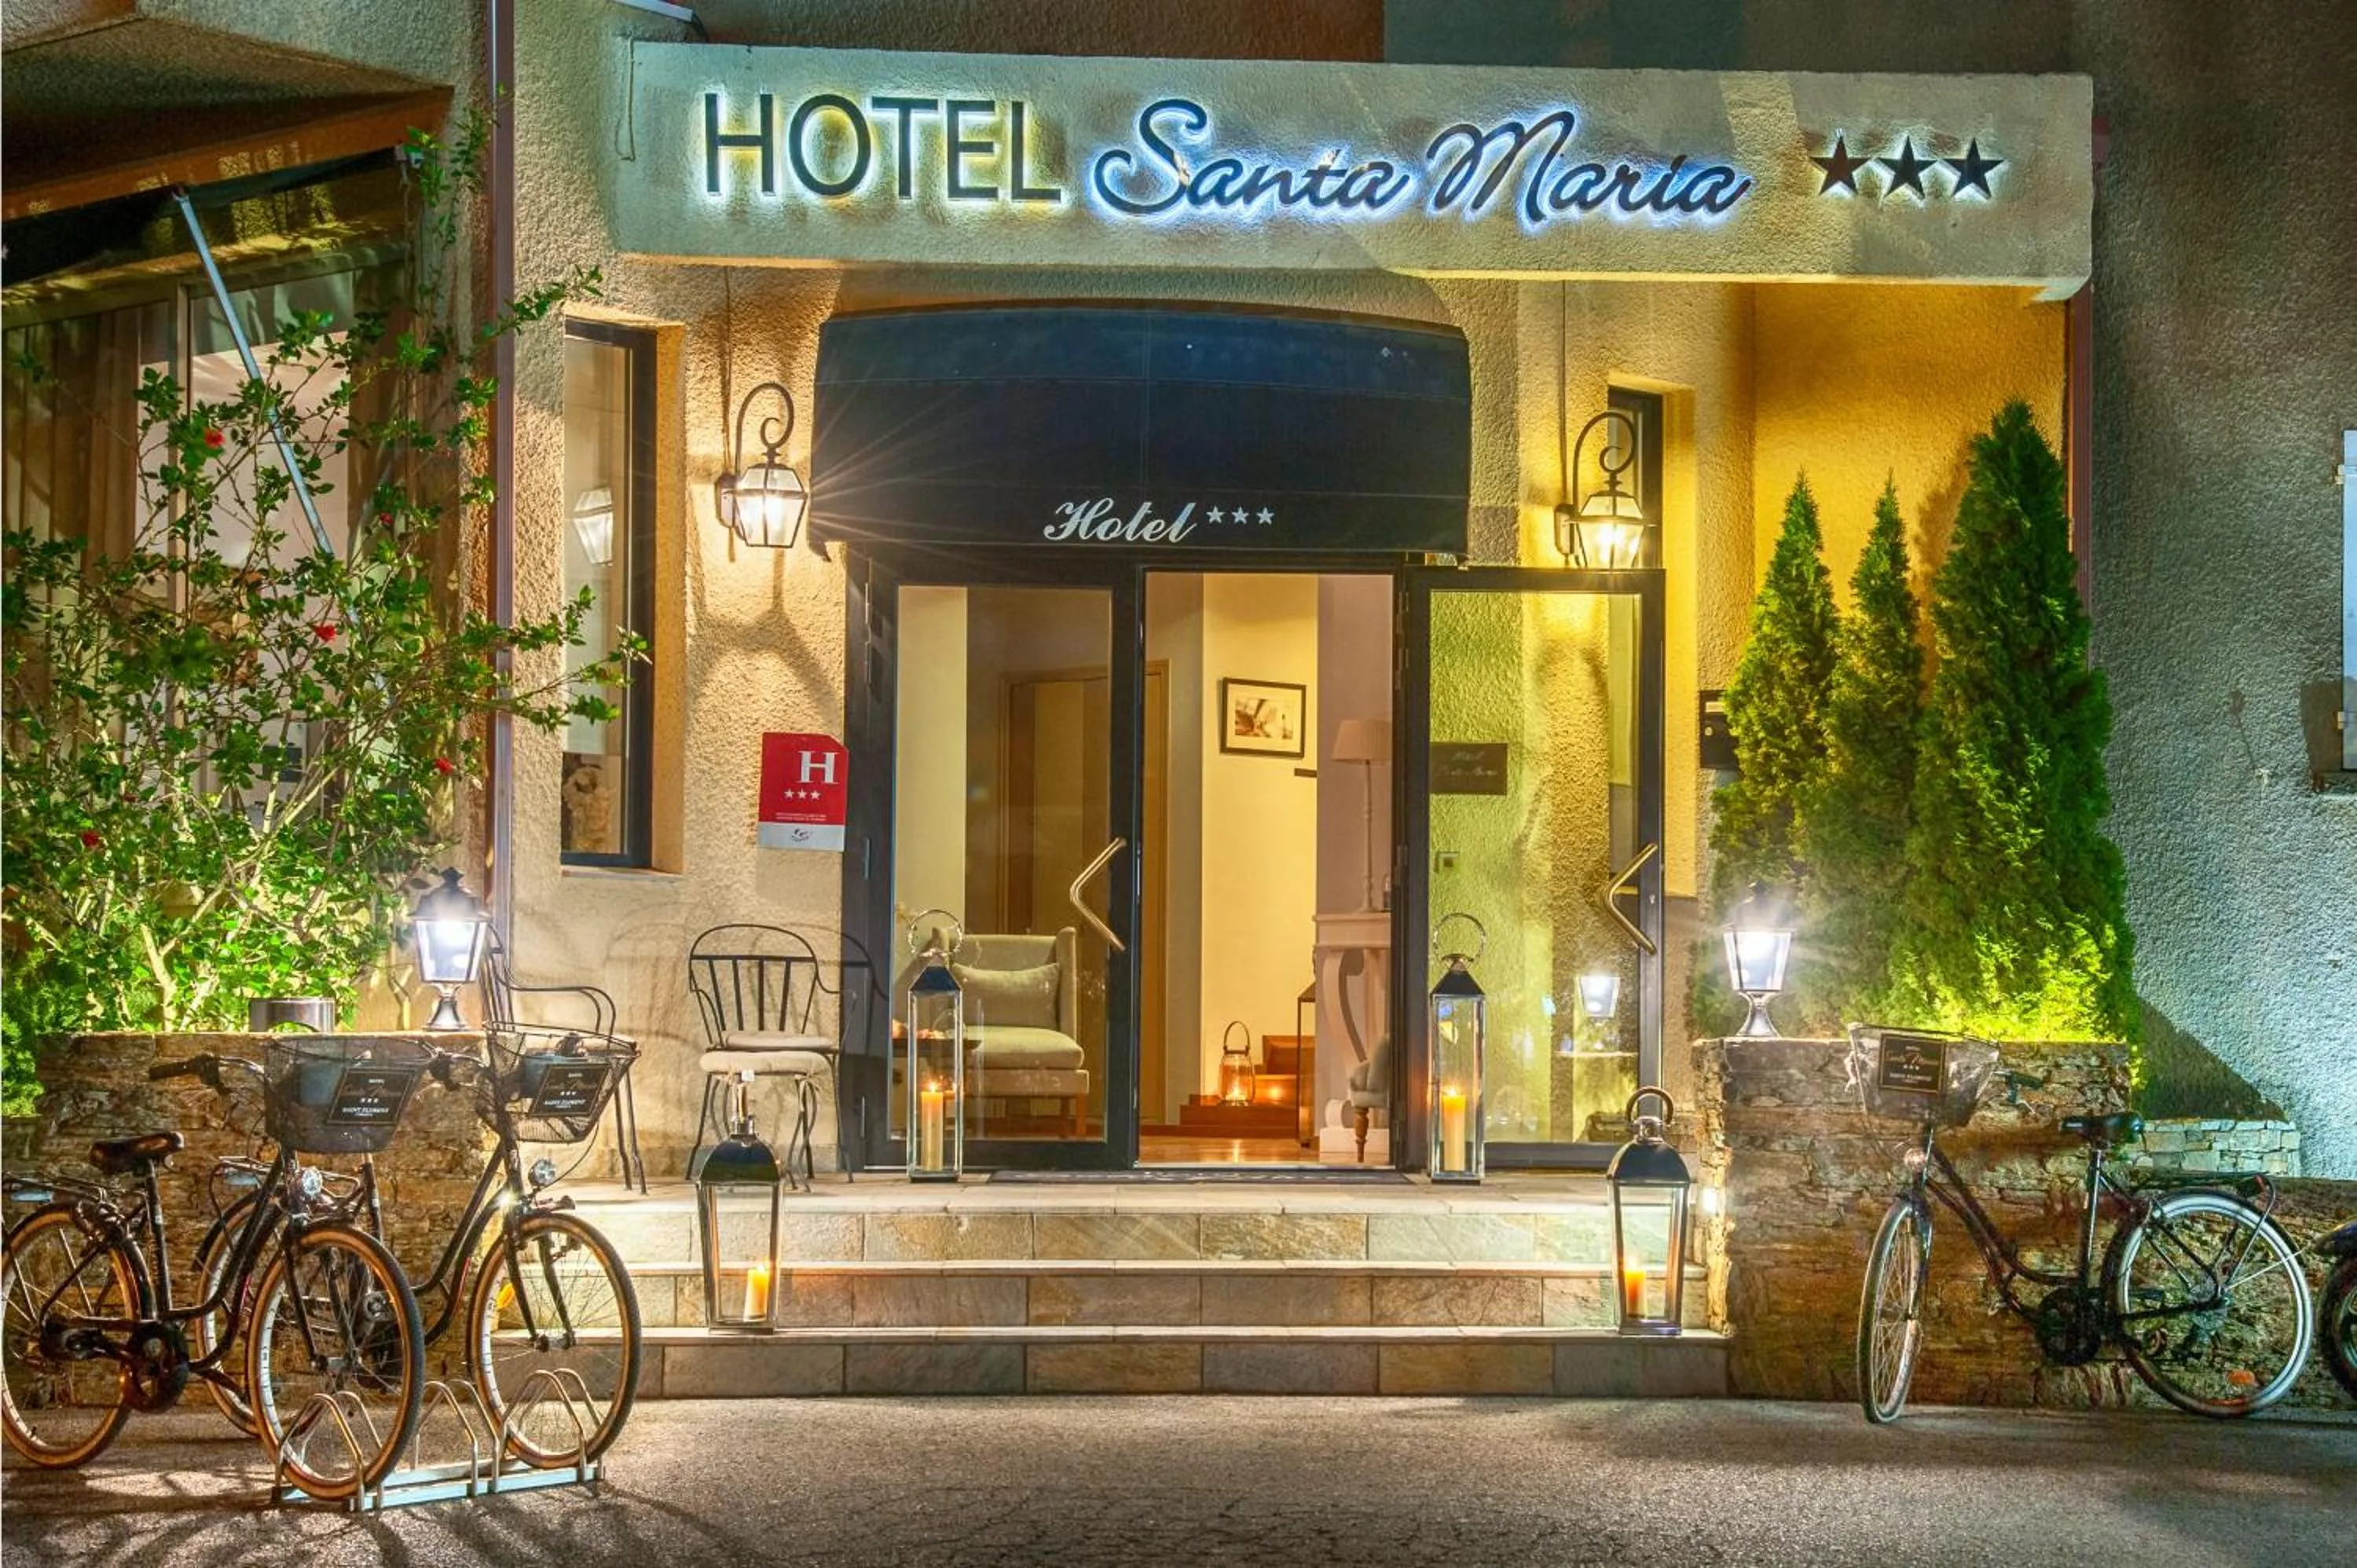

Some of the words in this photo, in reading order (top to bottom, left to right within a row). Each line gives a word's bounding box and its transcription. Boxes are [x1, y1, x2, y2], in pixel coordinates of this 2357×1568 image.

[705, 93, 1061, 200] HOTEL
[1094, 98, 1412, 214] Santa
[1426, 110, 1751, 222] Maria
[1043, 497, 1197, 543] Hotel
[797, 750, 839, 785] H
